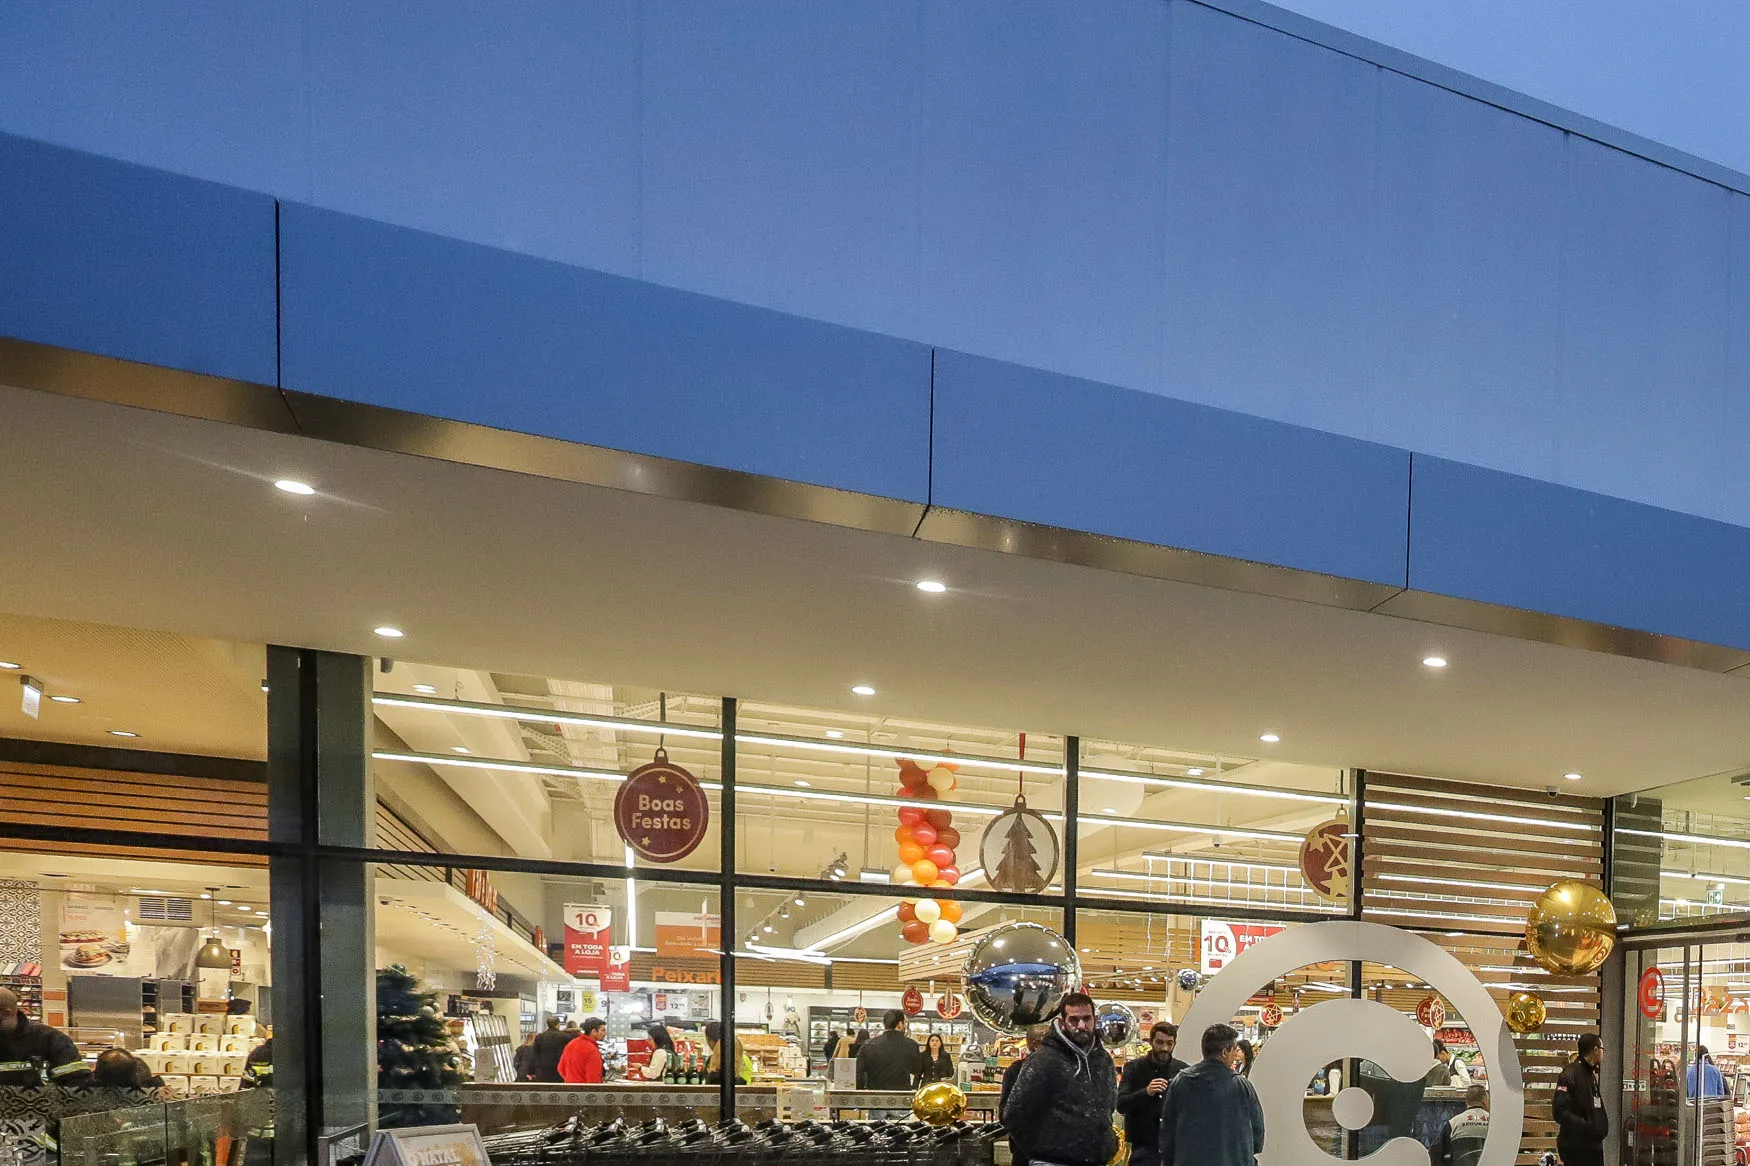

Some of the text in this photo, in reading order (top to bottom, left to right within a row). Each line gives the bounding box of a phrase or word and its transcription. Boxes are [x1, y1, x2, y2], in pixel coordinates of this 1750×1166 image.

[638, 794, 684, 811] Boas
[631, 812, 691, 830] Festas
[1239, 934, 1253, 942] EM
